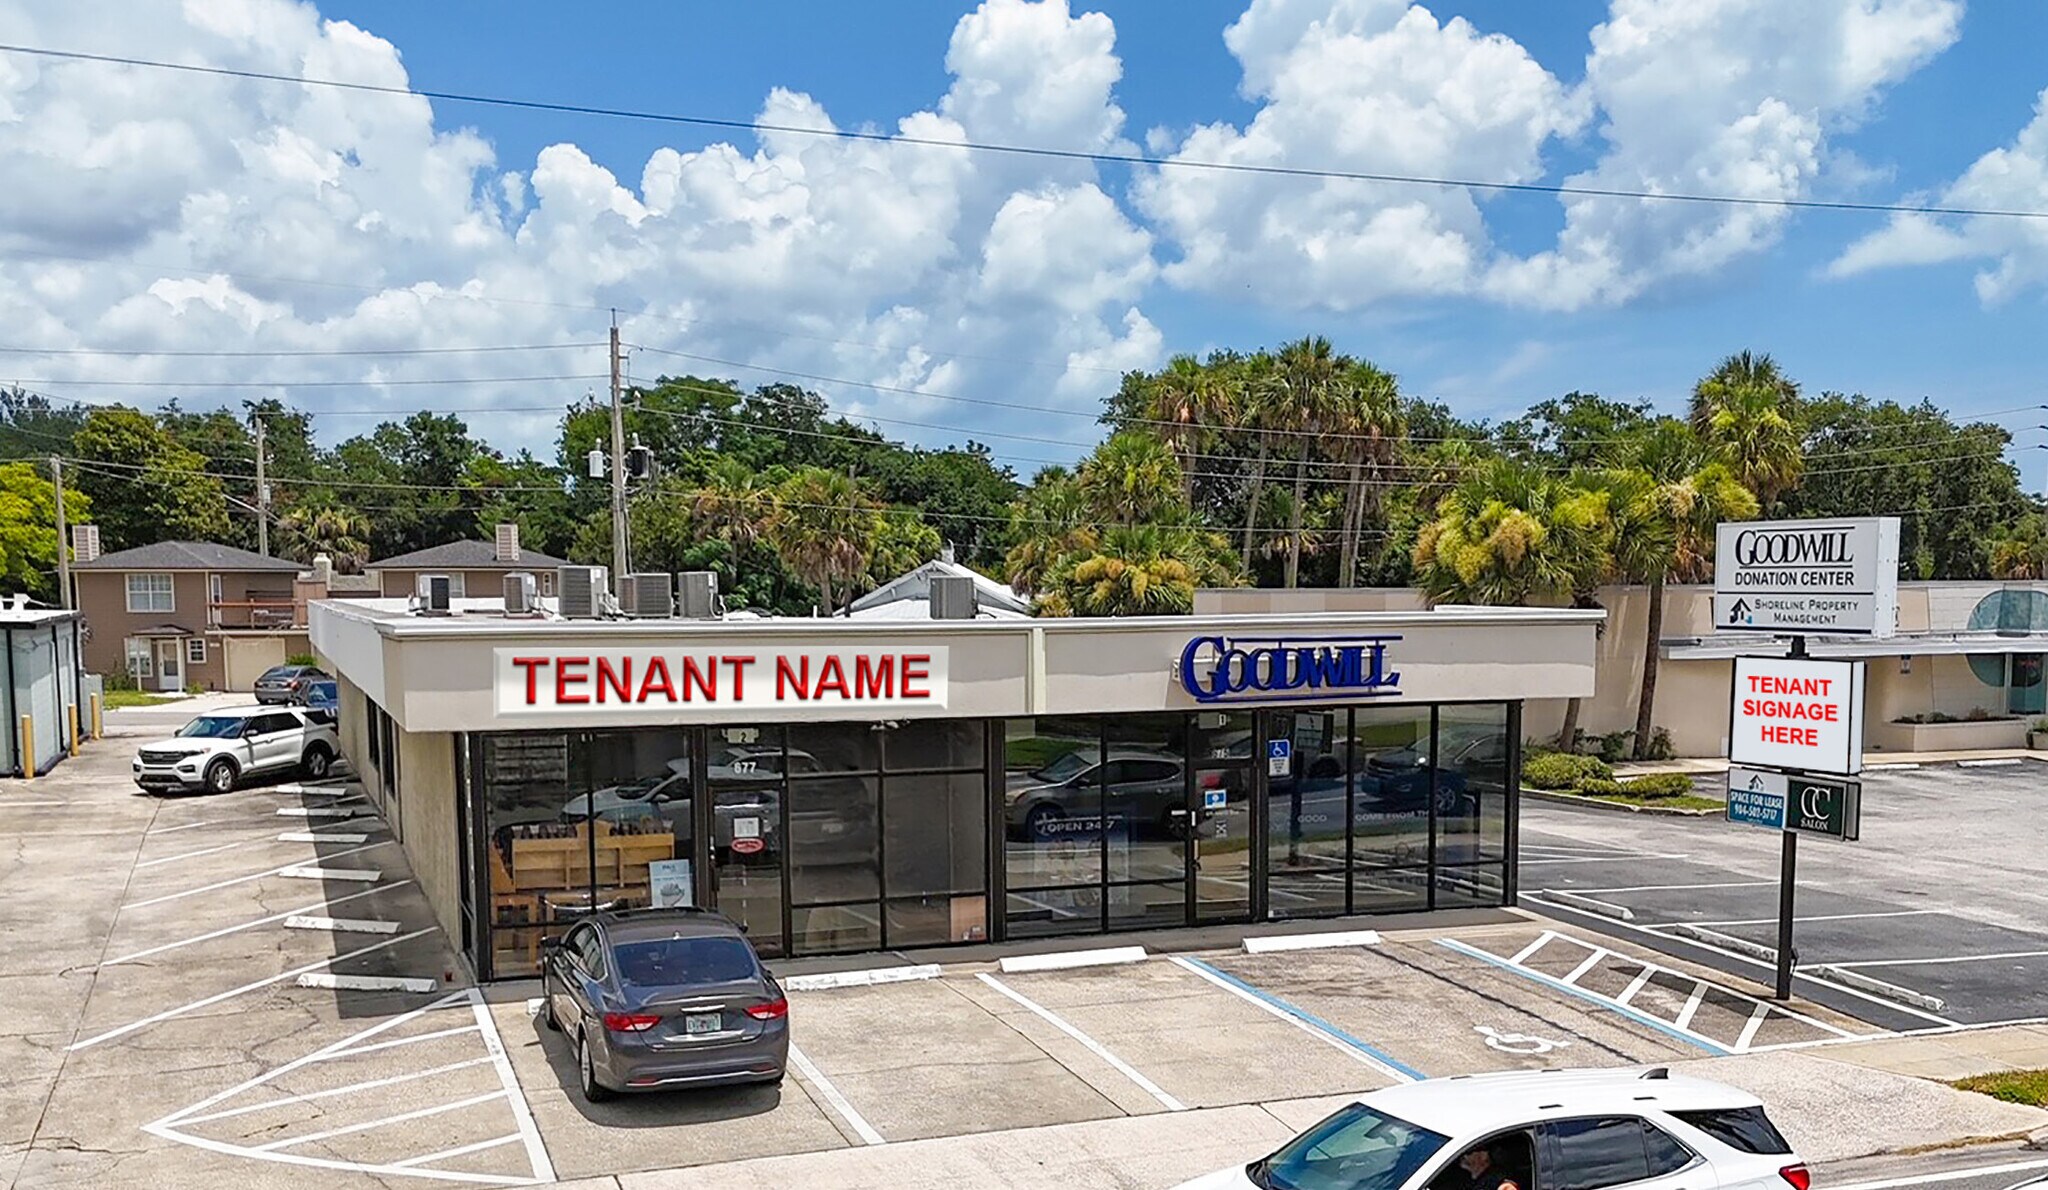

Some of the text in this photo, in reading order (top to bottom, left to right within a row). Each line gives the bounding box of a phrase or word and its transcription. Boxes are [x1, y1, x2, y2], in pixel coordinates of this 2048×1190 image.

[1735, 529, 1854, 566] GOODWILL
[1735, 571, 1854, 585] DONATION CENTER
[1754, 598, 1859, 610] SHORELINE PROPERTY
[1774, 613, 1836, 624] MANAGEMENT
[1180, 635, 1401, 700] GOODWILL
[512, 653, 931, 705] TENANT NAME
[1747, 676, 1832, 696] TENANT
[1743, 699, 1838, 722] SIGNAGE
[740, 731, 747, 743] 2
[1761, 725, 1818, 746] HERE
[734, 761, 757, 774] 677
[1730, 791, 1783, 809] SPACE FOR LEASE
[1047, 822, 1082, 832] OPEN
[1801, 817, 1829, 830] SALON
